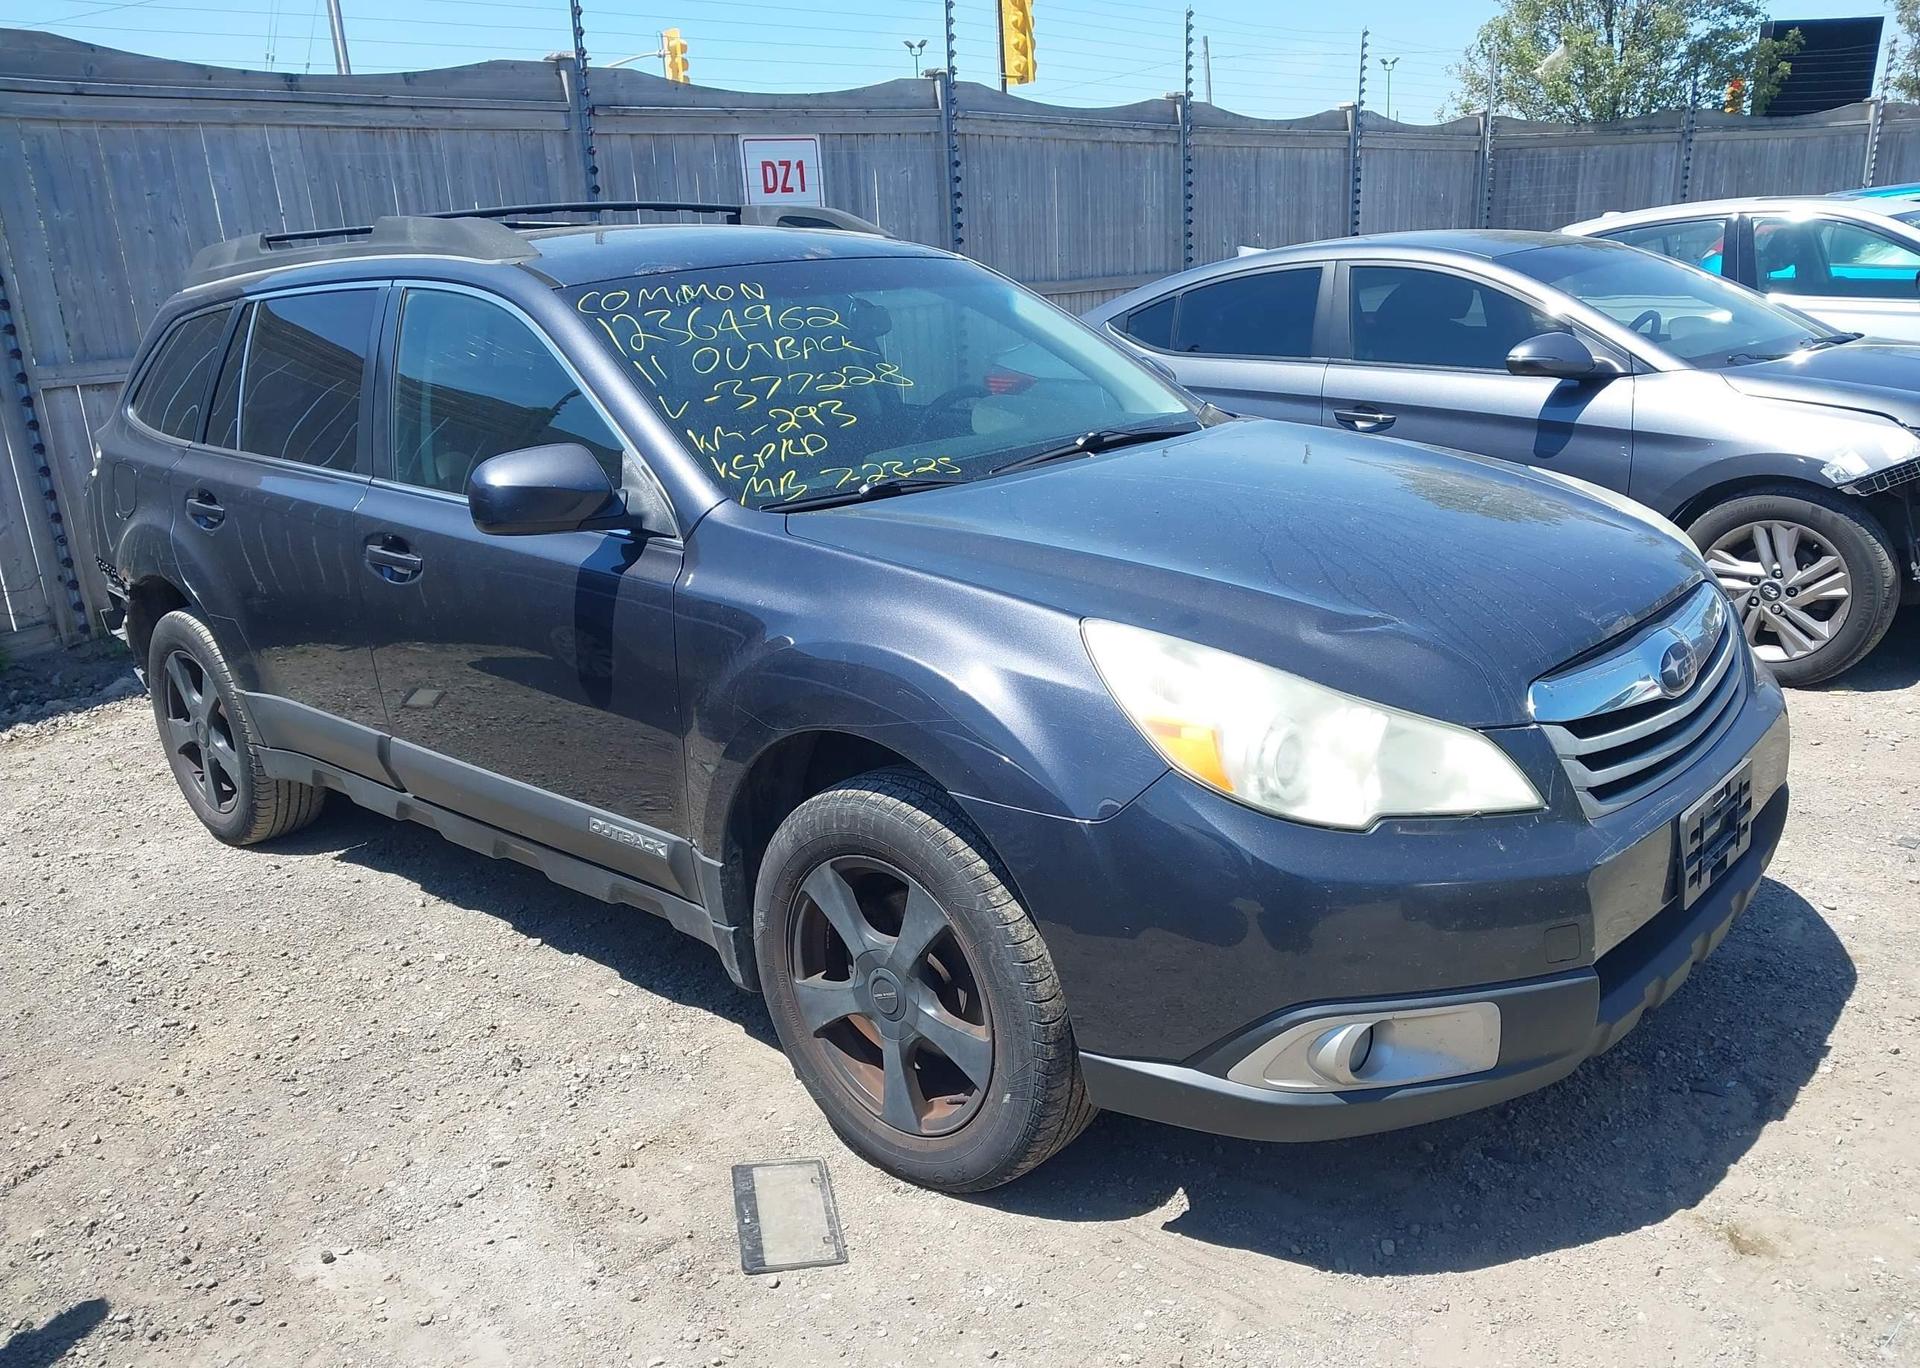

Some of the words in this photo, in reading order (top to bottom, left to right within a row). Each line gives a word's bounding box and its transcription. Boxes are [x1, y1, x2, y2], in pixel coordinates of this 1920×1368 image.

[760, 159, 806, 194] DZ1
[577, 282, 766, 314] COMMON
[596, 303, 851, 358] 12364962
[691, 335, 880, 374] OUTBACK
[590, 819, 667, 858] OUTBACK
